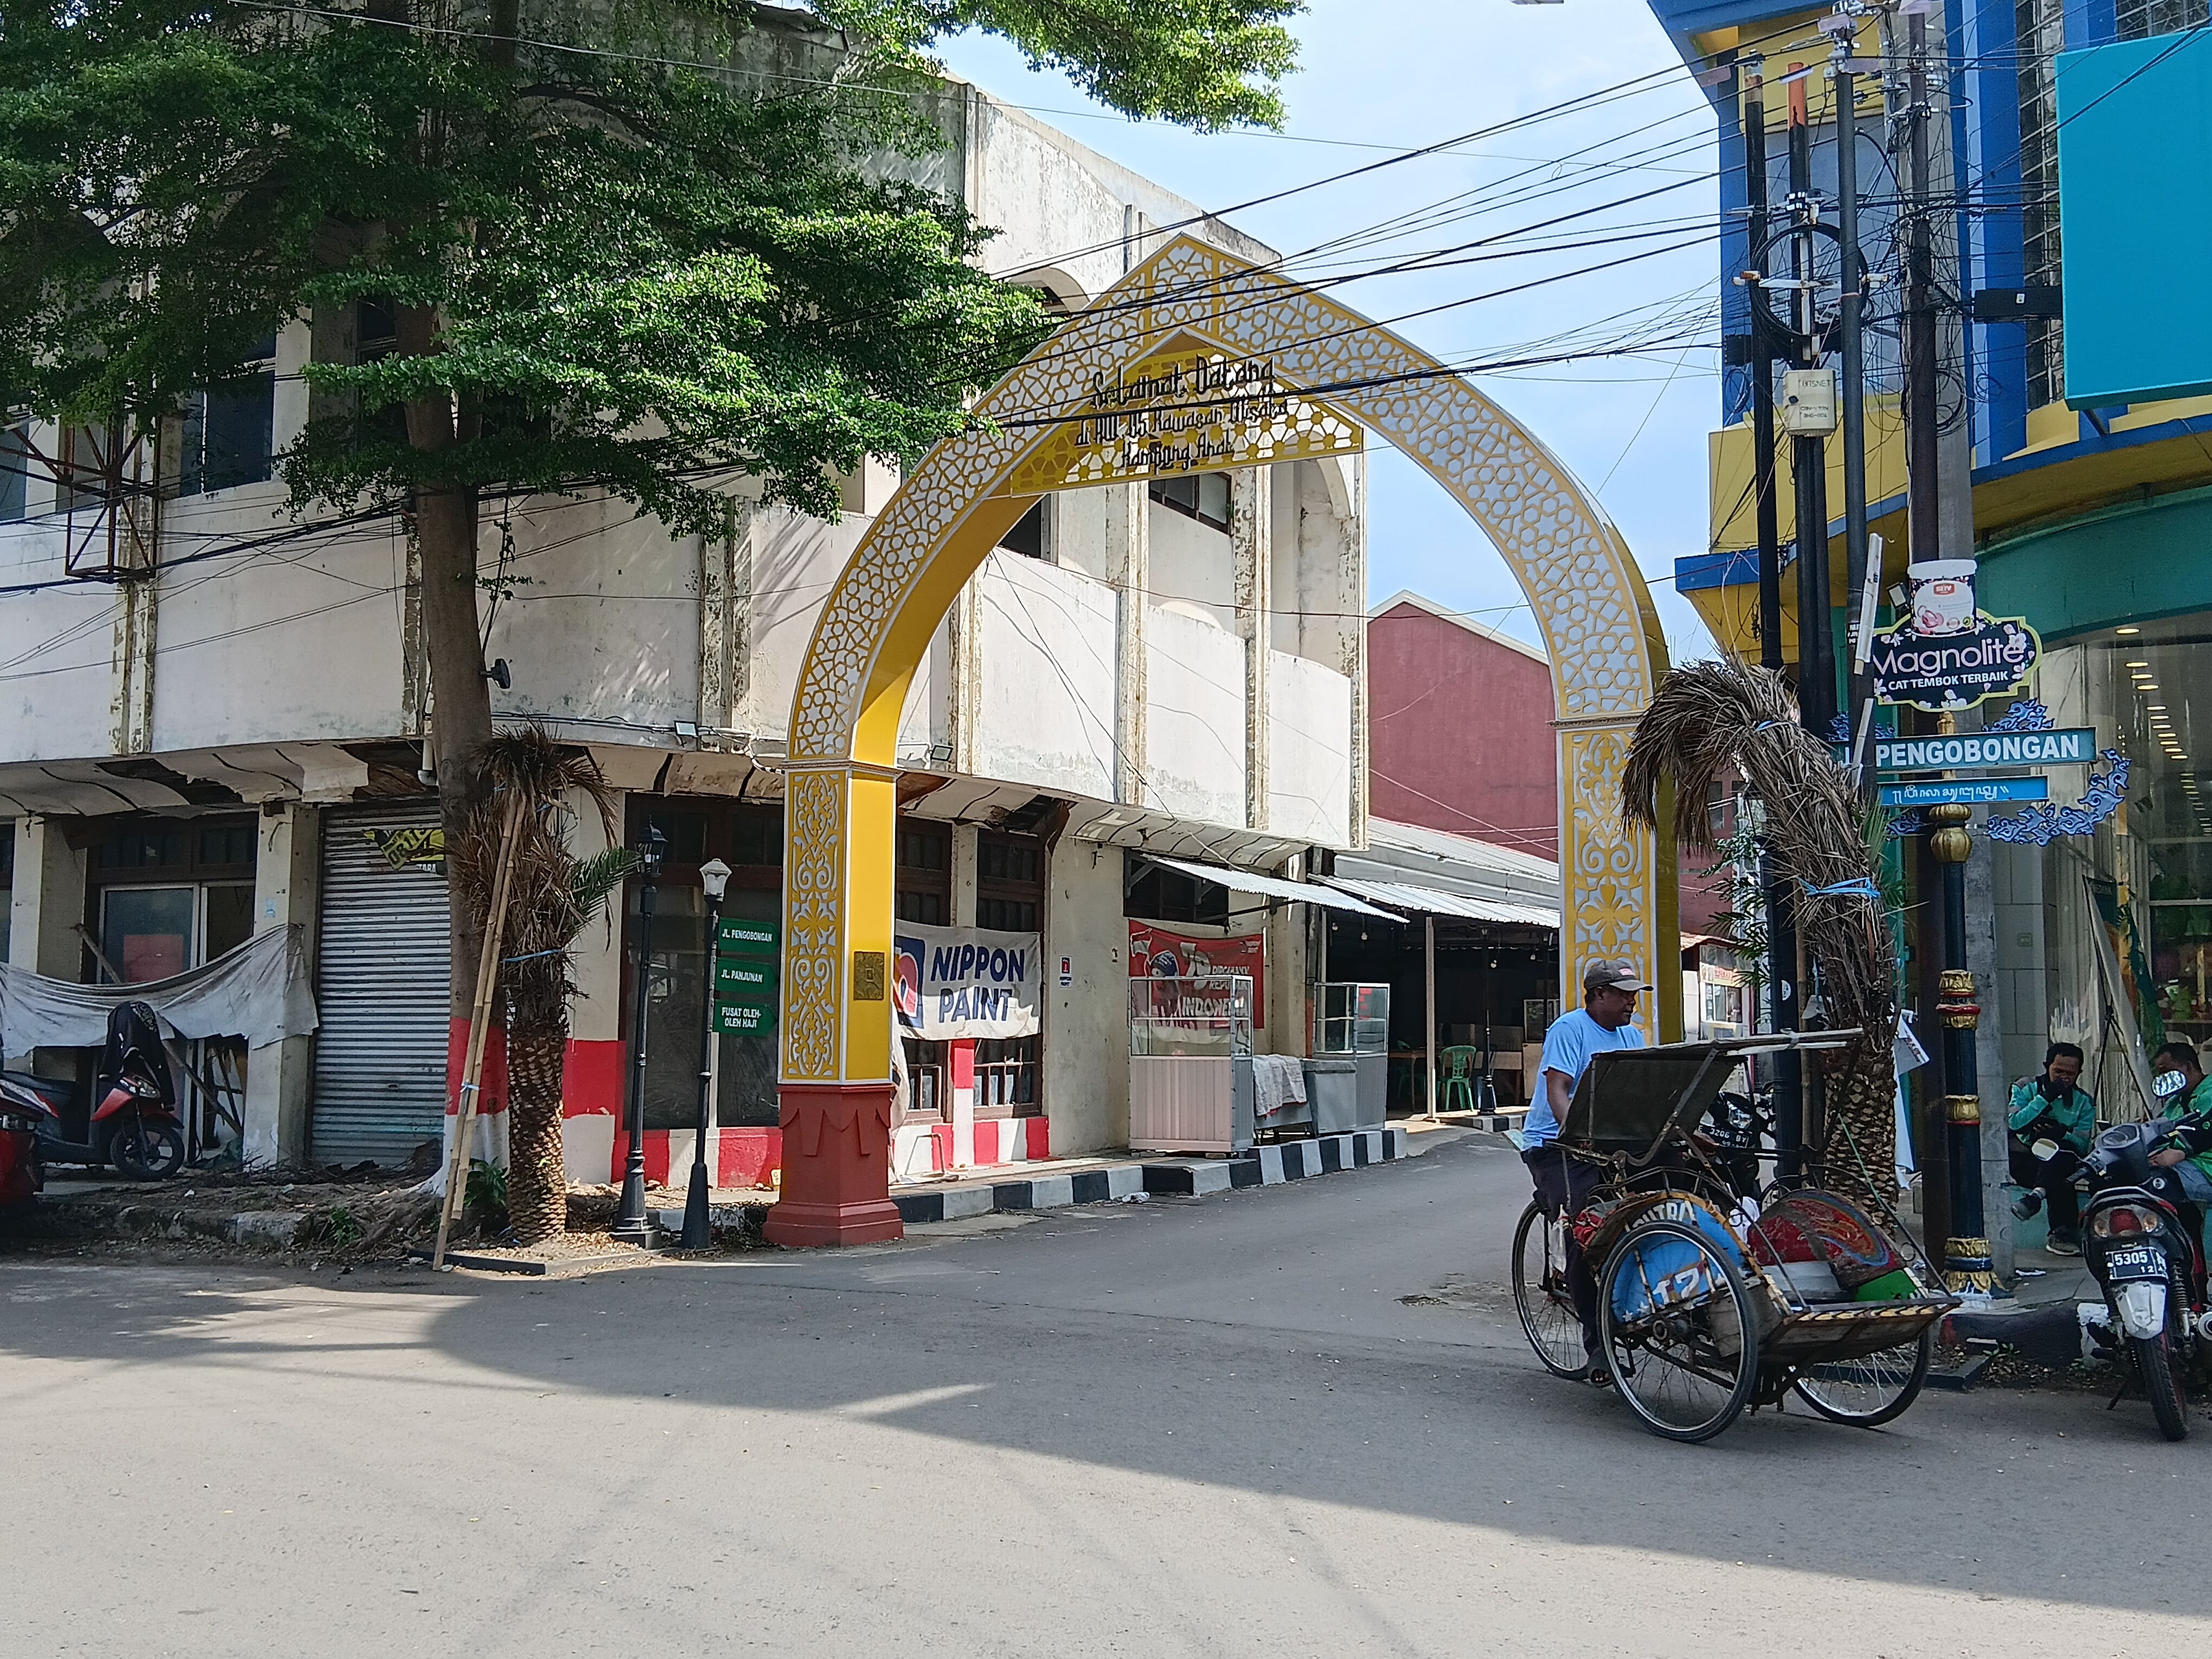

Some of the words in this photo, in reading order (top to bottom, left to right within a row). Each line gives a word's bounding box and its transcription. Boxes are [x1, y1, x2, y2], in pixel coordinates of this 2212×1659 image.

[1091, 362, 1187, 410] Selamat
[1196, 353, 1276, 397] Datang
[1075, 419, 1090, 446] di
[1153, 406, 1224, 433] Kawasan
[1229, 395, 1289, 423] Wisata
[1121, 434, 1192, 475] Kampung
[1873, 638, 2024, 677] Magnolite
[1888, 680, 1908, 690] CAT
[1908, 676, 1959, 689] TEMBOK
[1960, 671, 2008, 684] TERBAIK
[1876, 734, 2079, 767] PENGOBONGAN
[731, 930, 773, 942] PENGOBONGAN
[930, 944, 1025, 982] NIPPON
[731, 970, 763, 983] PANJUNAN
[722, 1007, 742, 1017] PUSAT
[743, 1008, 761, 1018] OLEH-
[938, 986, 1013, 1024] PAINT
[724, 1018, 741, 1027] OLEH
[742, 1019, 757, 1028] HAJI
[2114, 1251, 2148, 1266] 5305
[2140, 1265, 2155, 1273] 12
